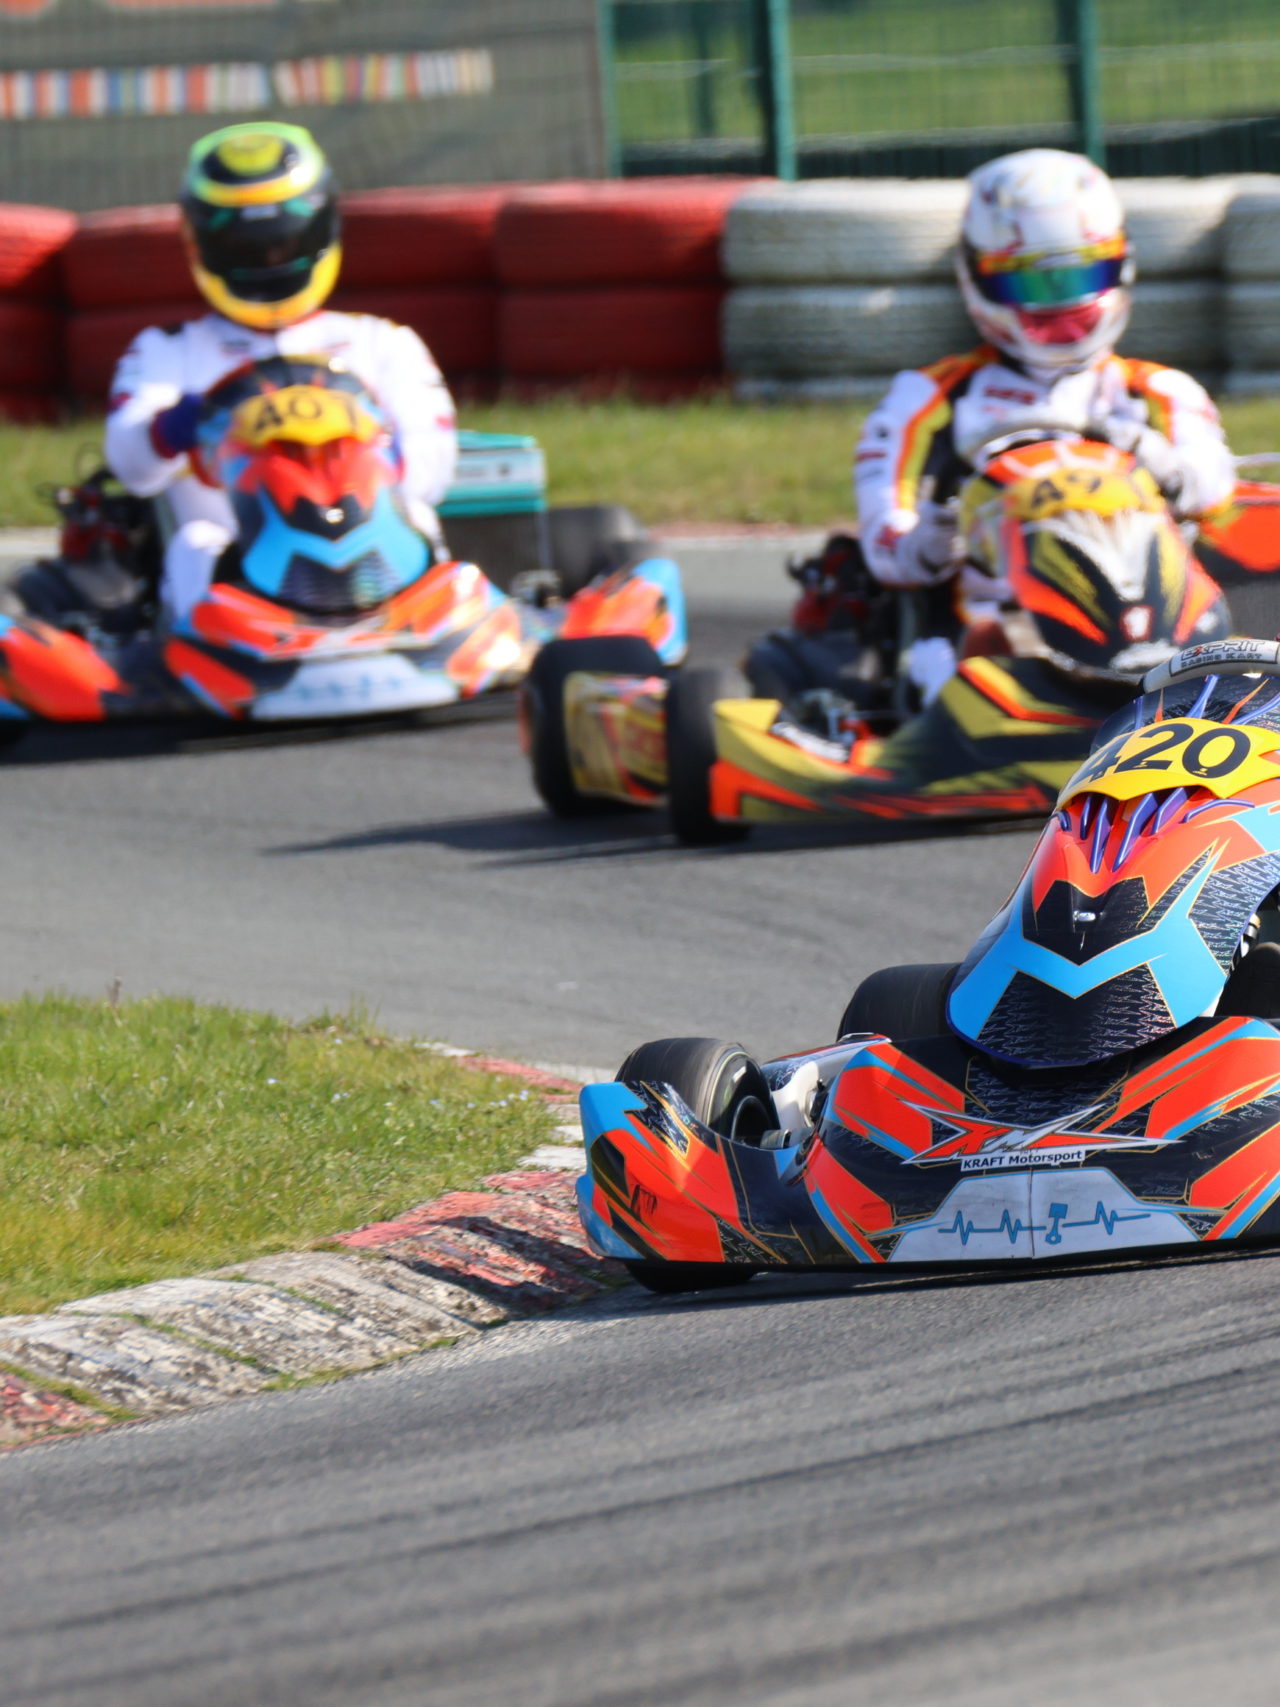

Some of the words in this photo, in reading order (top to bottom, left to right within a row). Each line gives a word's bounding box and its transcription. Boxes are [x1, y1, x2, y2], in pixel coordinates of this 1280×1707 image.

[1181, 640, 1265, 661] EXPRIT
[1069, 723, 1251, 788] 420
[963, 1156, 1006, 1169] KRAFT
[1008, 1150, 1083, 1165] Motorsport
